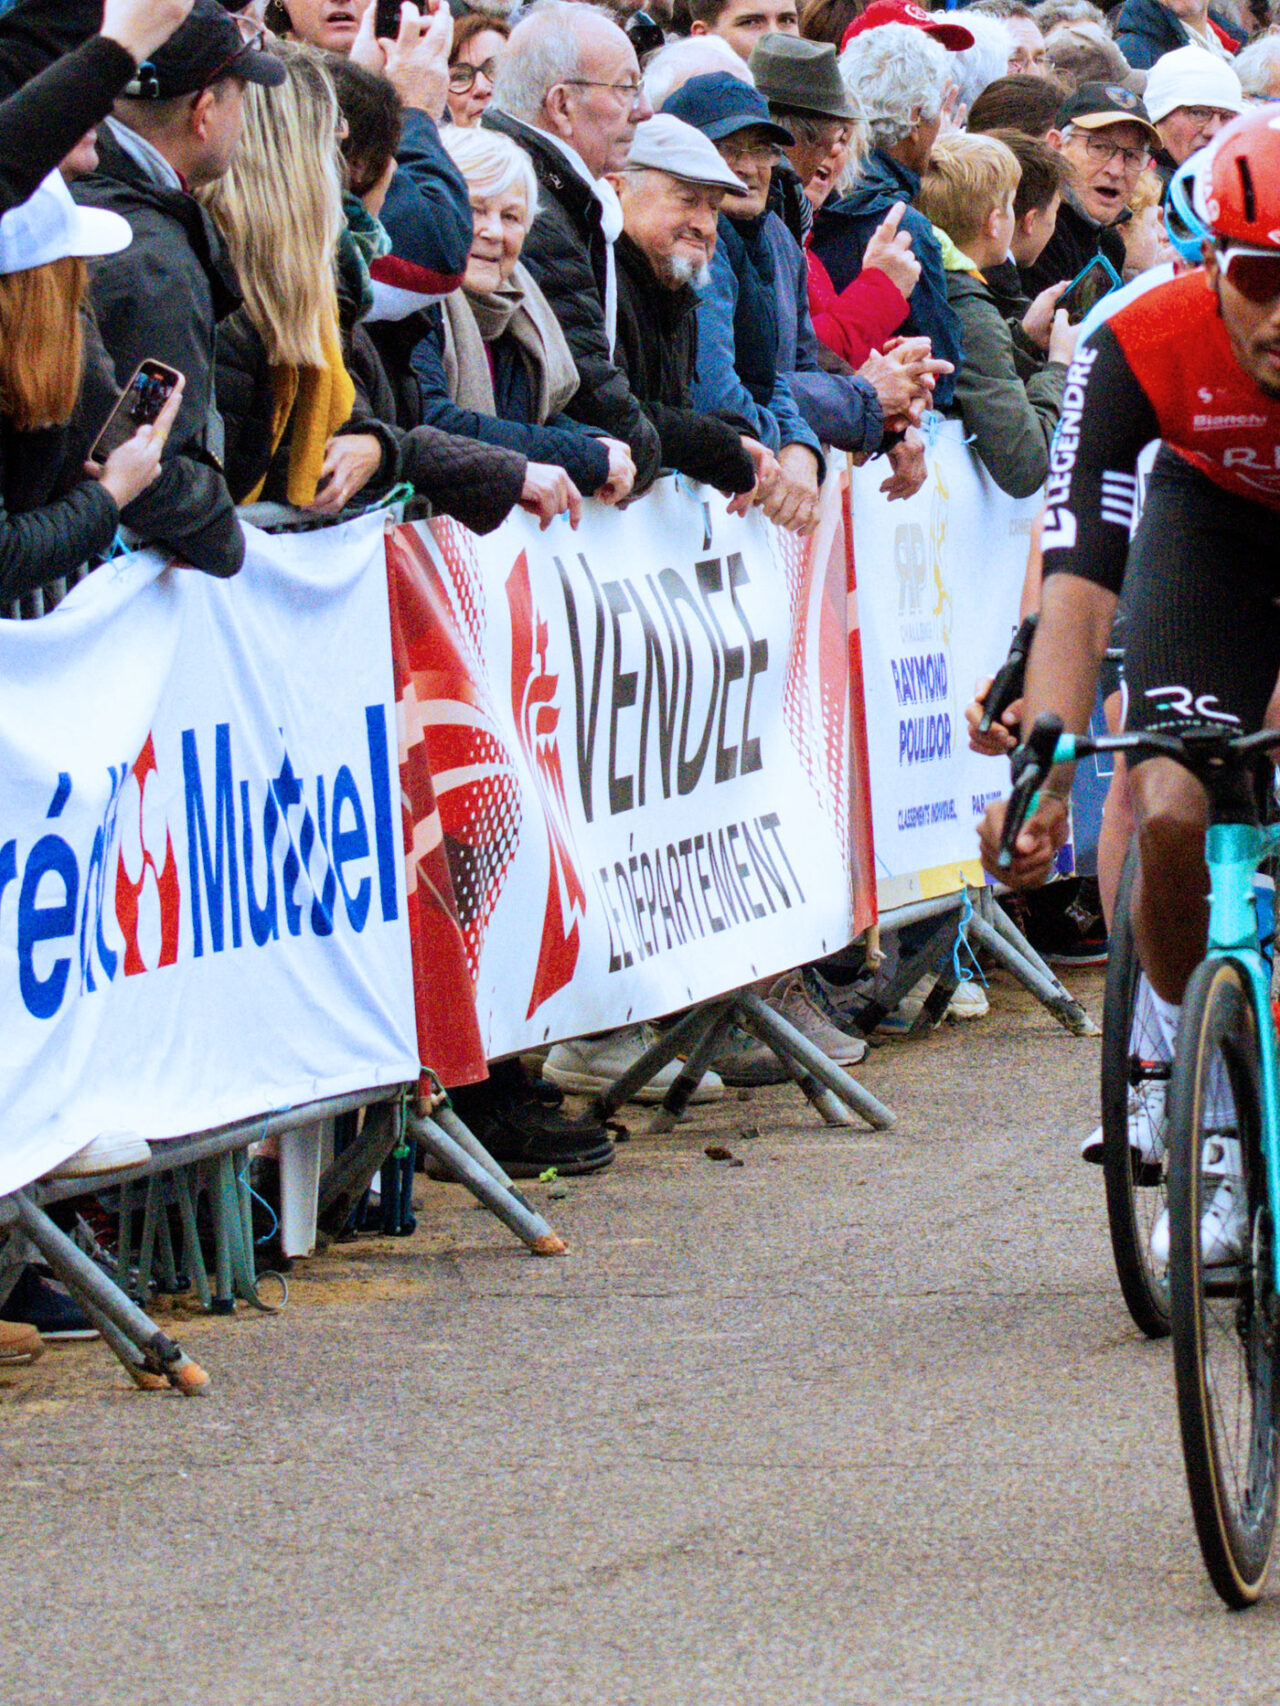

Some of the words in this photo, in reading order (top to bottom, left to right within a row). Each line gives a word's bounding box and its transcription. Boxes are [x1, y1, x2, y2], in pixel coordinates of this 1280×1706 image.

[1046, 346, 1099, 508] LEGENDRE
[554, 501, 769, 824] VENDÉE
[891, 652, 948, 706] RAYMOND
[899, 712, 951, 768] POULIDOR
[182, 703, 399, 958] Mutuel
[614, 811, 807, 964] DÉPARTEMENT
